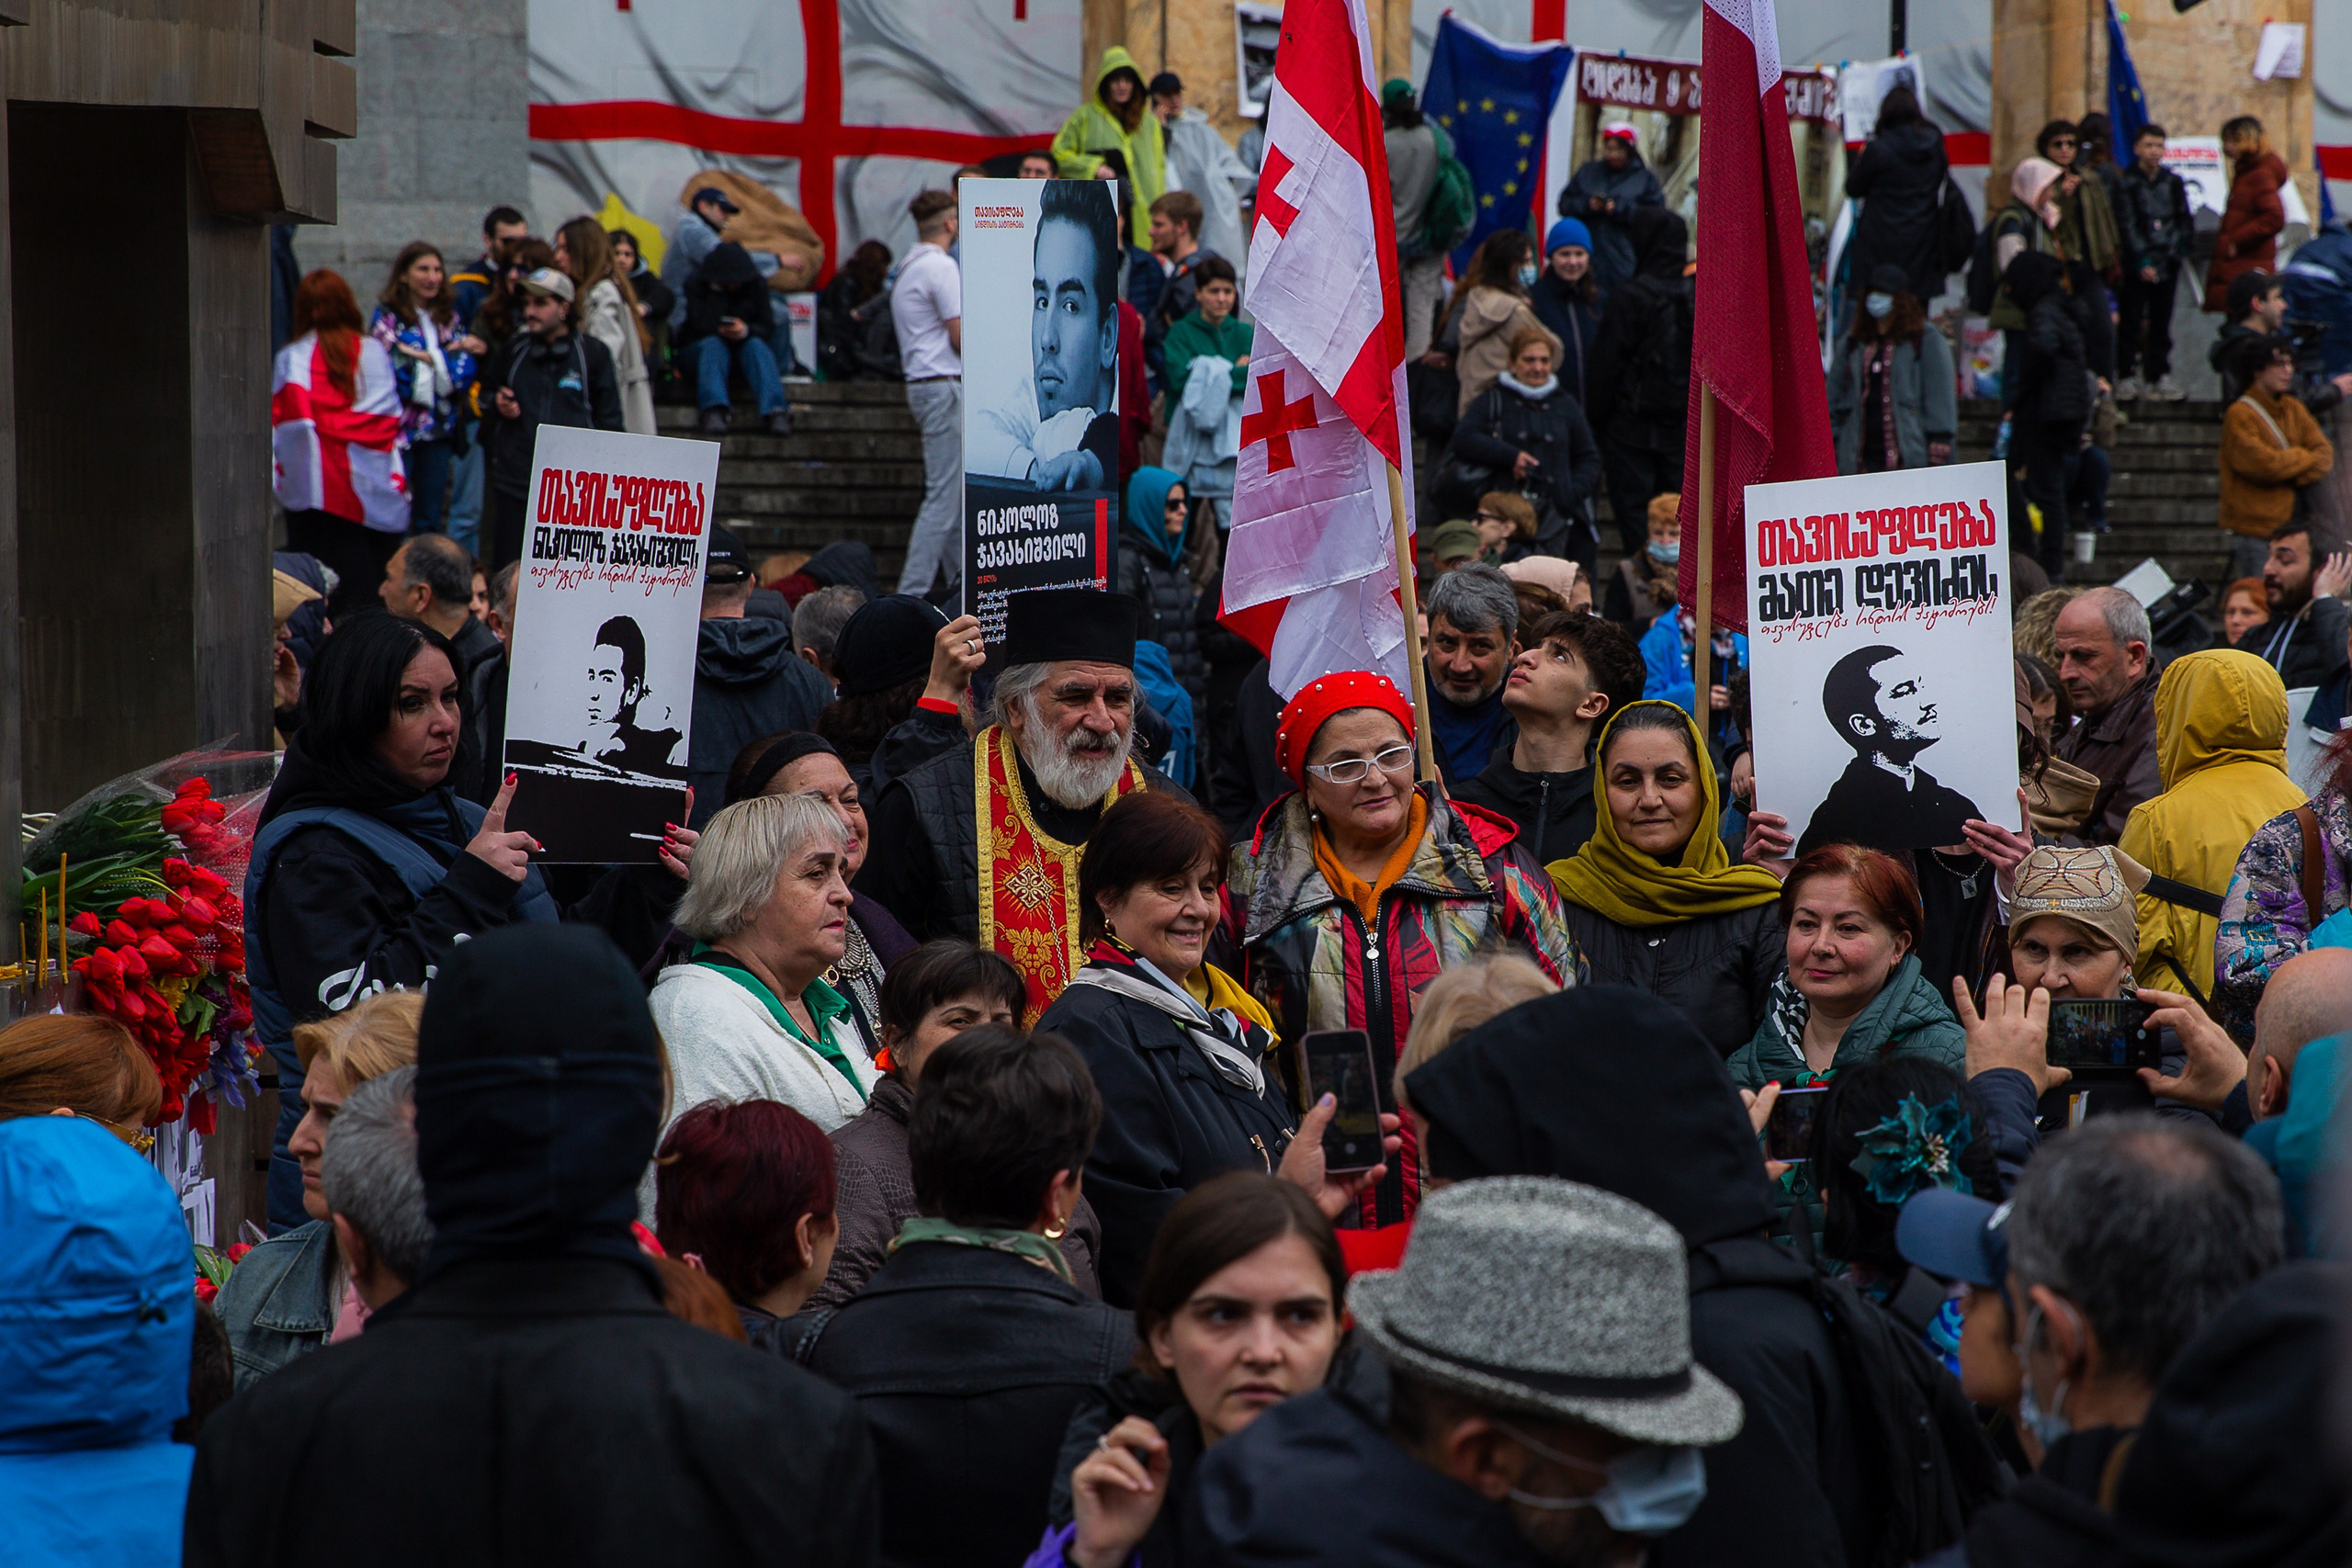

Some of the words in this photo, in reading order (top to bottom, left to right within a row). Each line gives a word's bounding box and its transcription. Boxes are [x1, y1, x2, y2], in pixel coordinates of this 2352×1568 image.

[974, 206, 1024, 218] თავისუფლება
[537, 468, 705, 536] თავისუფლება
[977, 502, 1059, 536] ნიკოლოზ
[532, 526, 606, 564] ნიკოლოზ
[977, 532, 1086, 569] ჯავახიშვილი
[1758, 499, 1996, 567] თავისუფლება
[531, 557, 594, 591] თავისუფლება
[598, 557, 640, 592] სინდისის
[1758, 568, 1845, 622] მათე
[1855, 554, 1998, 611] დევიძეს
[1761, 607, 1849, 643] თავისუფლება
[1855, 600, 1913, 634] სინდისის
